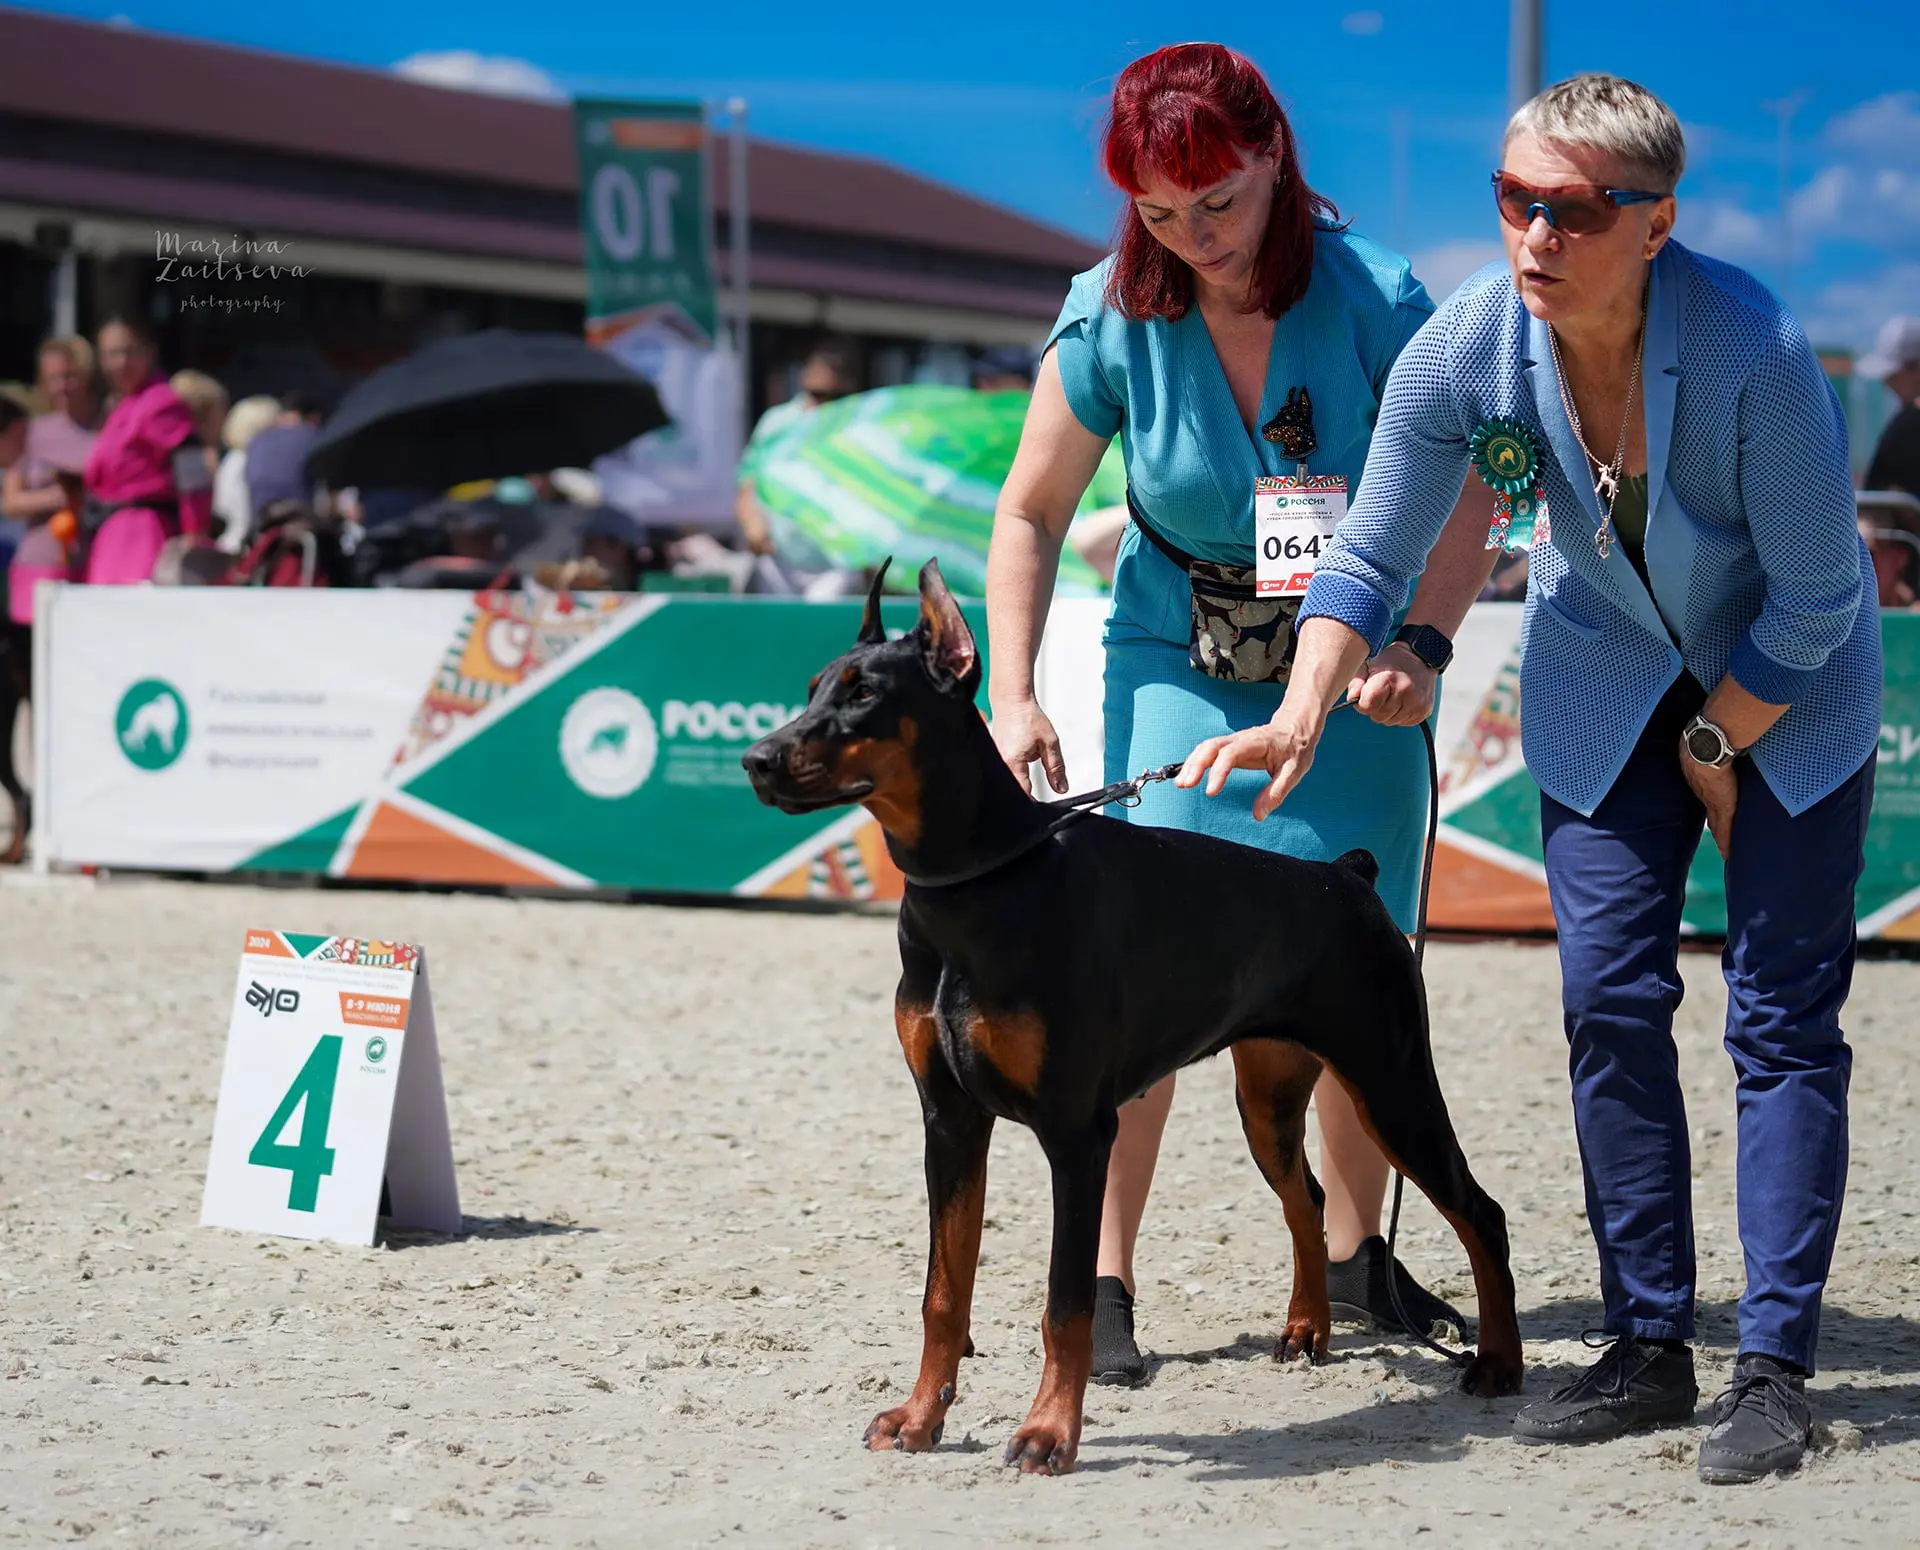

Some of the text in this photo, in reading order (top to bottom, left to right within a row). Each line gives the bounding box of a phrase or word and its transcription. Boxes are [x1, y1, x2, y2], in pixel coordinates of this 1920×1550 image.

[1290, 498, 1326, 506] РОССИЯ
[1295, 577, 1310, 586] 9.0
[661, 700, 808, 741] РОССИ
[248, 1034, 343, 1212] 4
